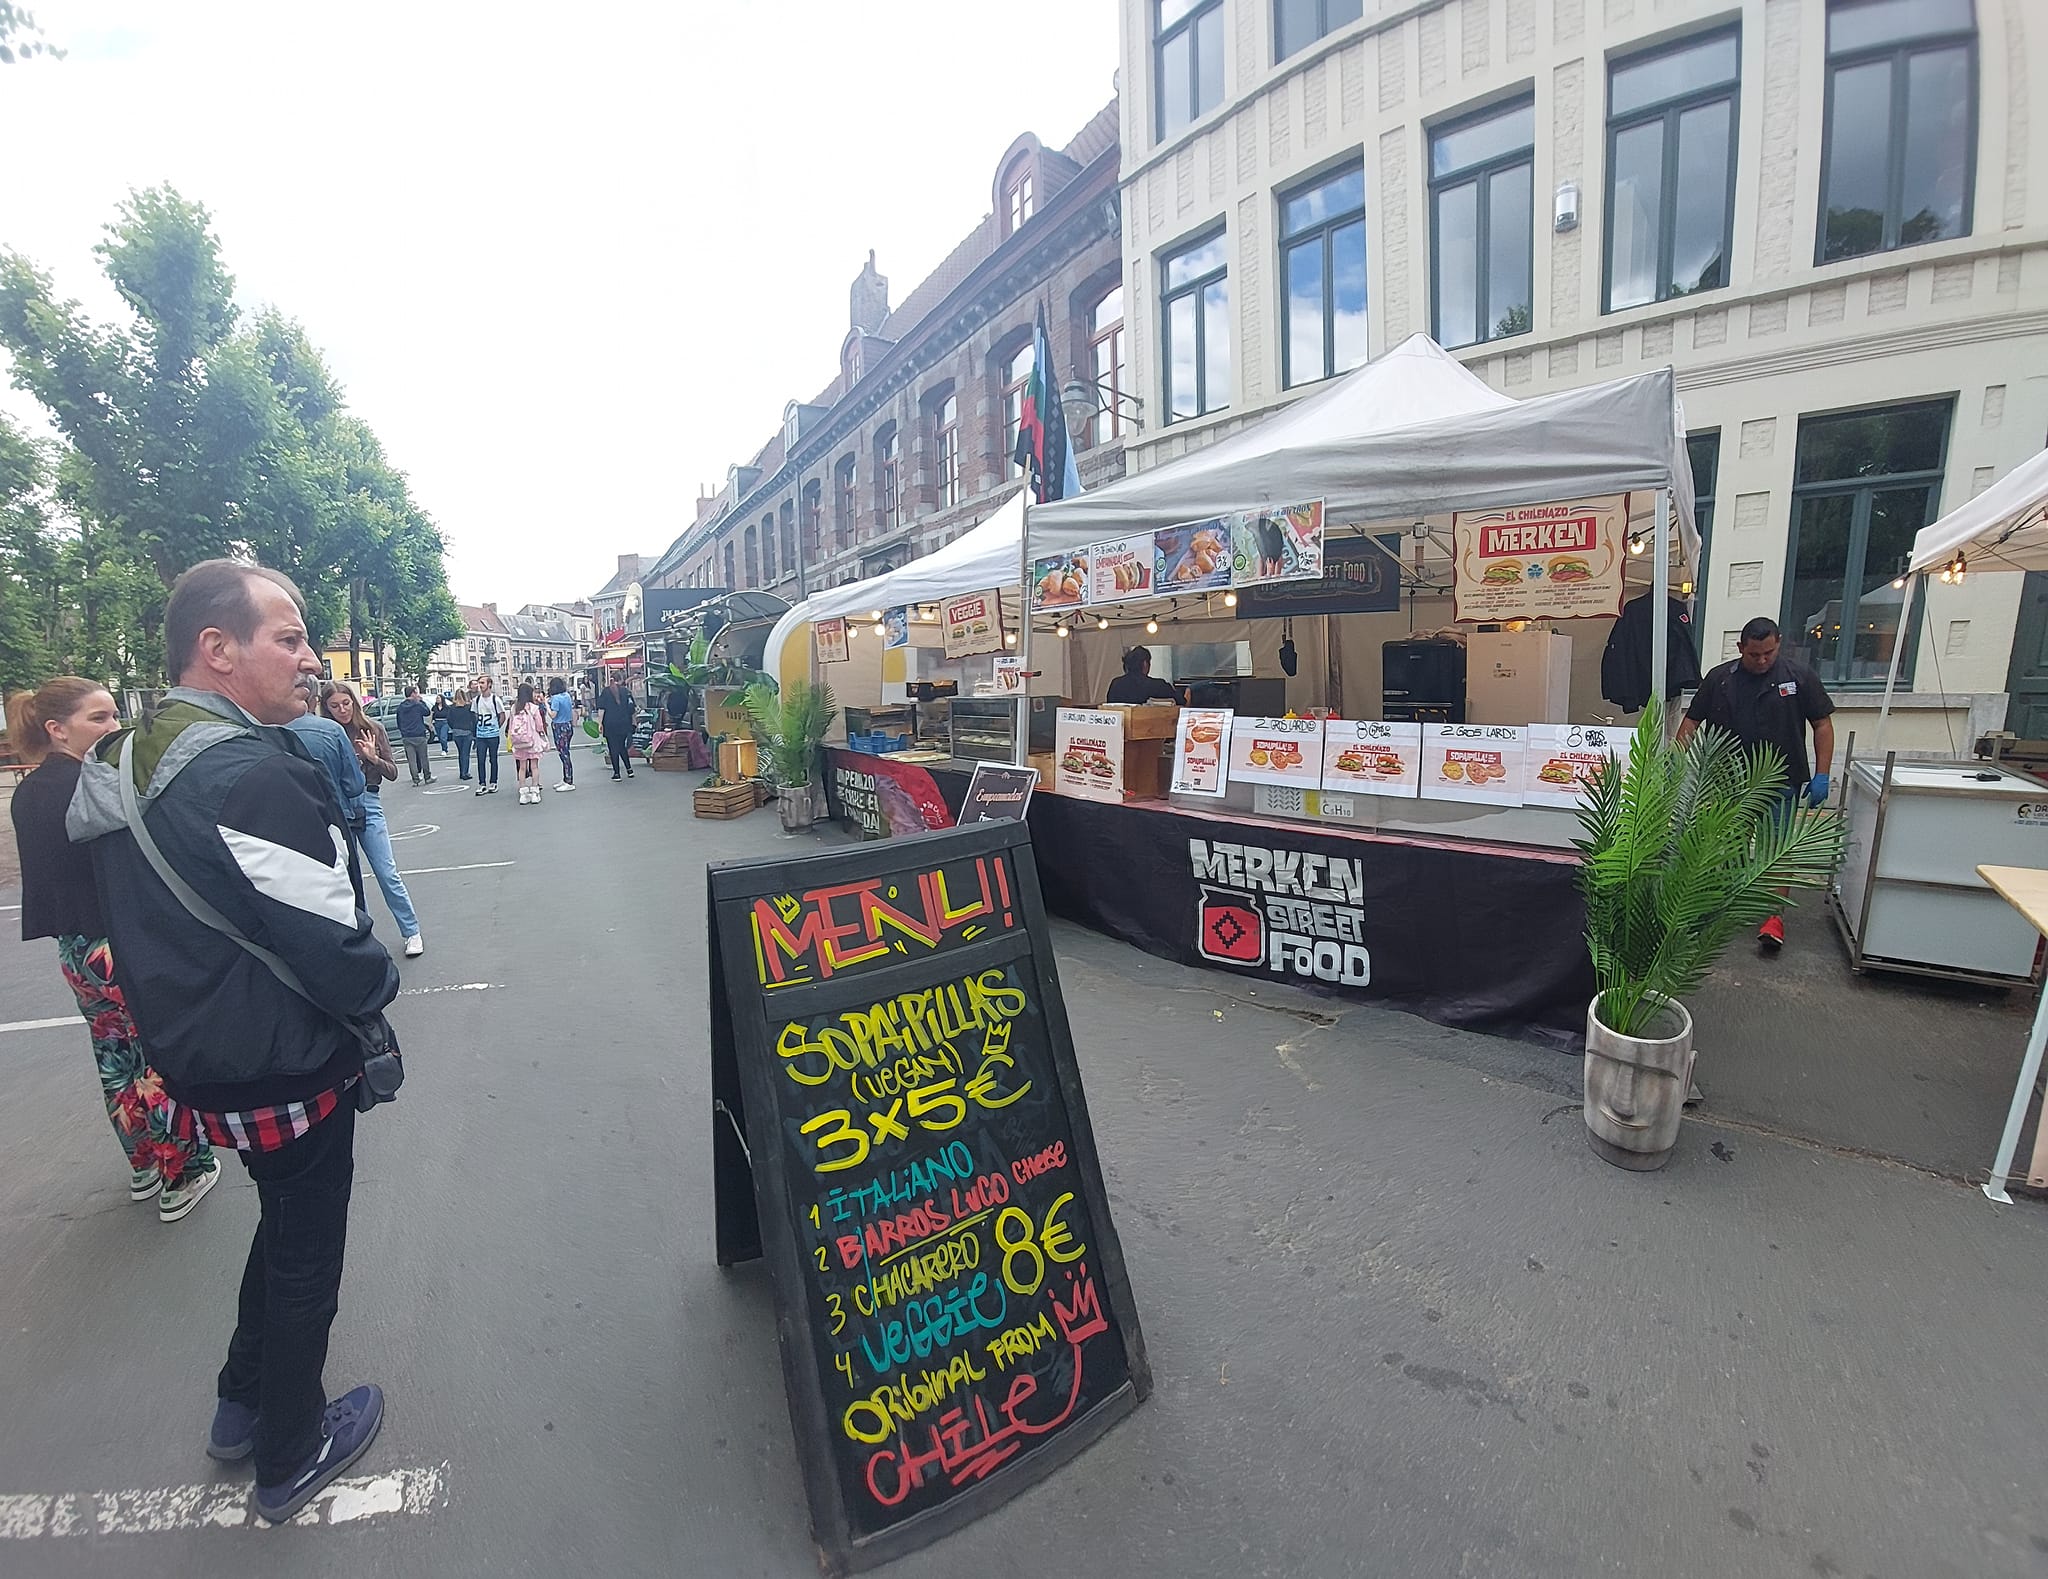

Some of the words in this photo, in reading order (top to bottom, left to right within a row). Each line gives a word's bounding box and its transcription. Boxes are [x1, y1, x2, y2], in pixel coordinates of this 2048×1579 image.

[1505, 510, 1516, 522] EL
[1487, 521, 1588, 554] MERKEN
[1343, 561, 1367, 583] FOOD
[950, 601, 982, 622] VEGGIE
[1255, 718, 1270, 729] 2
[1356, 720, 1369, 740] 8
[1440, 725, 1455, 736] 2
[1566, 725, 1583, 748] 8
[1189, 838, 1365, 906] MERKEN
[1265, 895, 1366, 943] STREET
[809, 1203, 822, 1230] 1
[814, 1246, 830, 1272] 2
[836, 1199, 951, 1270] BARROS
[825, 1293, 847, 1336] 3
[834, 1351, 855, 1389] 4
